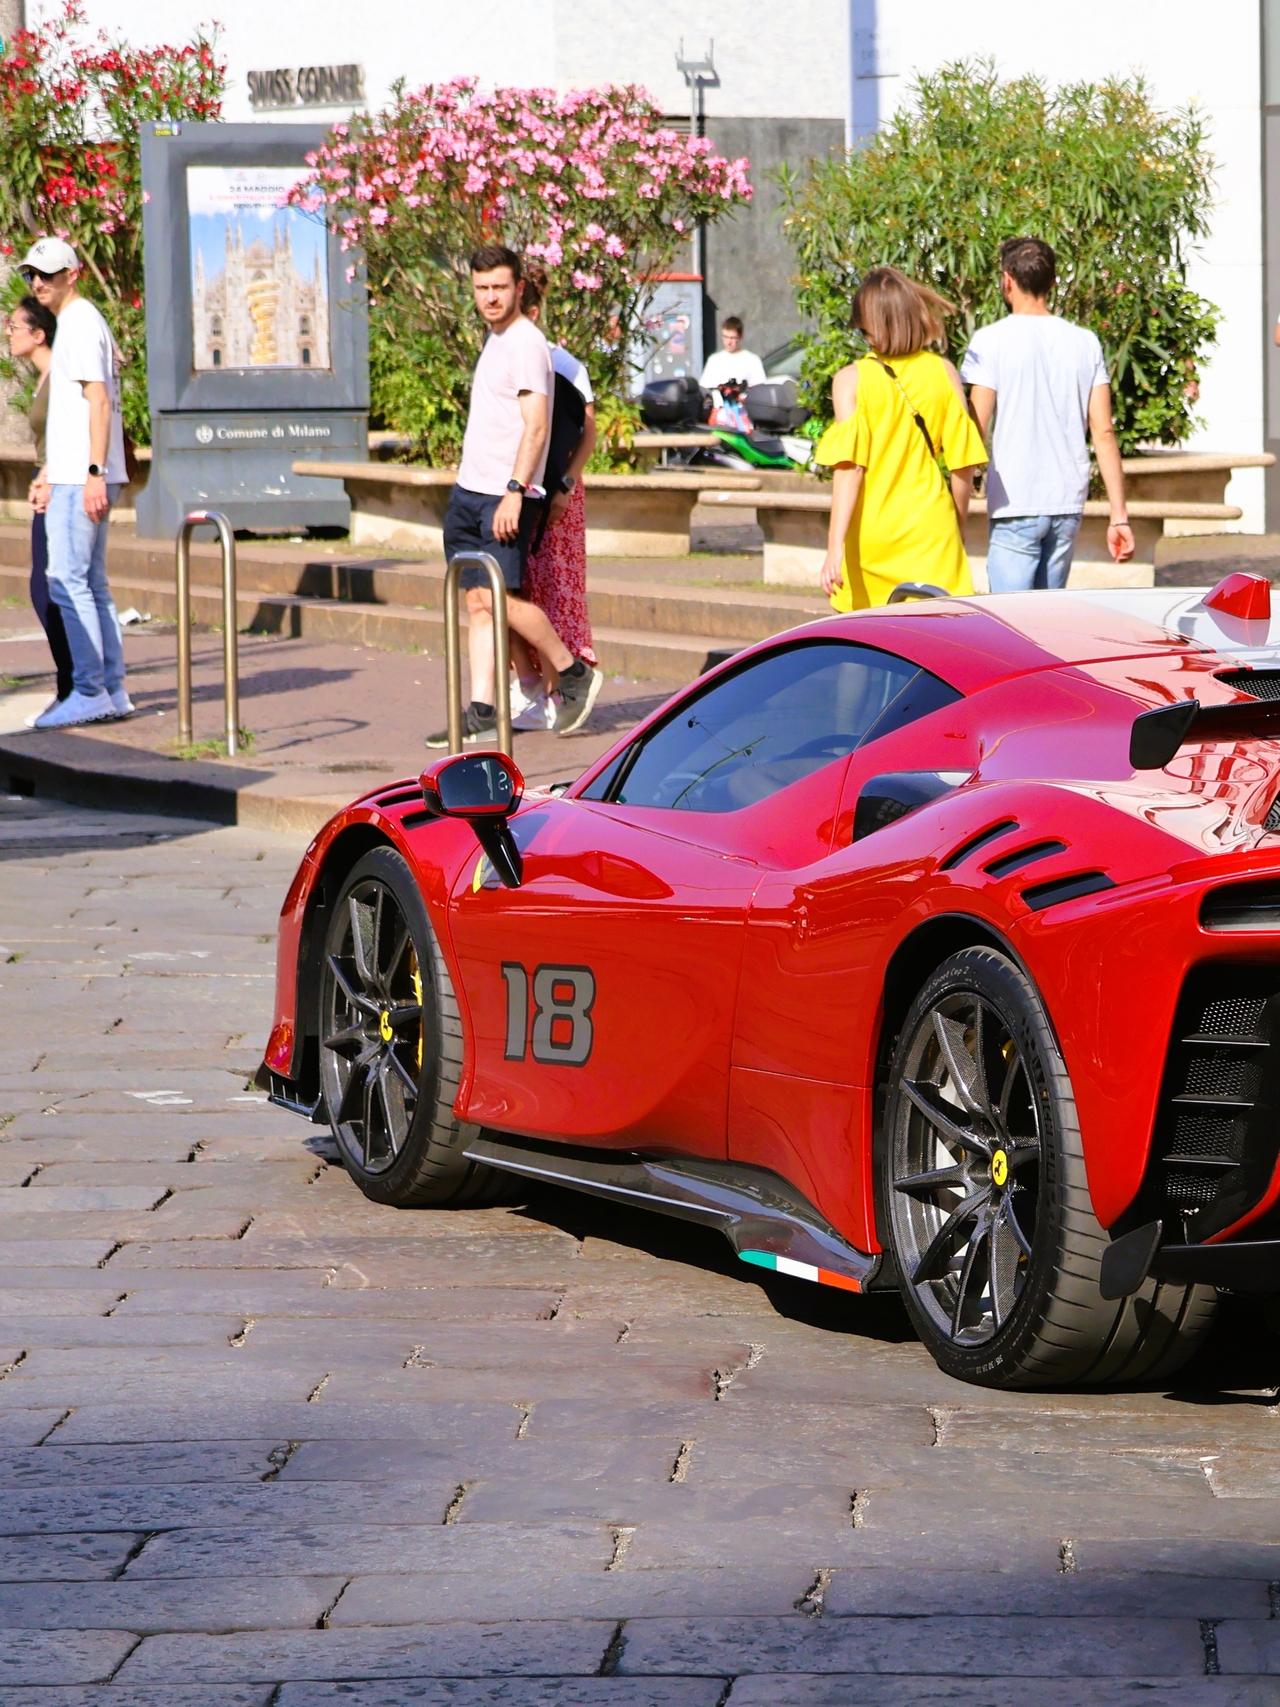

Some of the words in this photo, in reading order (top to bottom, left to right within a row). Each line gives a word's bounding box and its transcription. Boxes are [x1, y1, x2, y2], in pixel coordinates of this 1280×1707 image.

[216, 427, 268, 440] Comune
[271, 424, 285, 438] di
[287, 423, 331, 438] Milano
[501, 960, 597, 1068] 18
